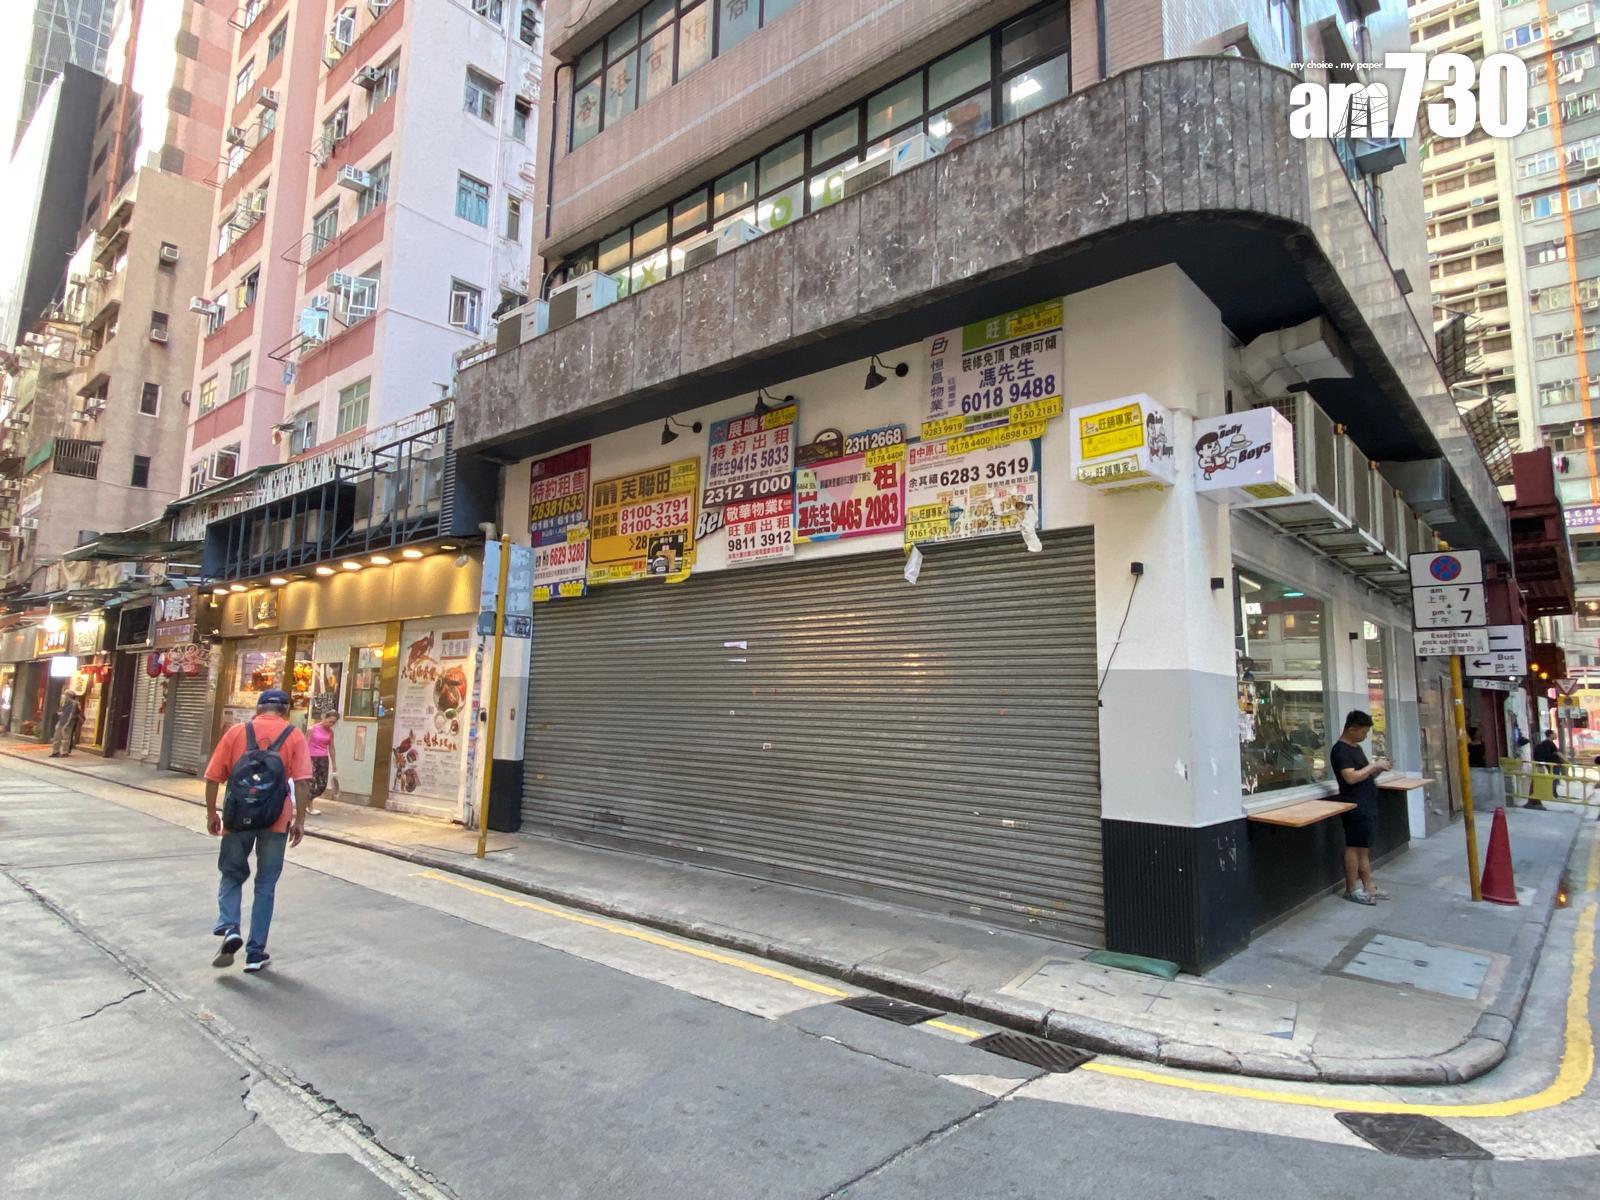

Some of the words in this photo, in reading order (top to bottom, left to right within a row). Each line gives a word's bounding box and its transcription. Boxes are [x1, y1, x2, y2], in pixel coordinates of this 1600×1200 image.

[962, 348, 1005, 372] 裝修免頂
[1009, 334, 1057, 360] 食牌可傾
[979, 358, 1035, 389] 馮先生
[962, 388, 1003, 413] 6018
[1010, 374, 1056, 402] 9488
[1013, 410, 1034, 421] 9150
[1036, 404, 1057, 416] 2181
[924, 427, 942, 437] 9283
[944, 422, 963, 433] 9919
[1000, 431, 1021, 442] 6898
[1023, 424, 1044, 437] 6317
[845, 437, 869, 455] 2311
[871, 428, 901, 449] 2668
[950, 442, 969, 453] 9178
[971, 436, 991, 448] 4400
[1239, 441, 1271, 464] Boys
[731, 453, 757, 475] 9415
[761, 445, 789, 468] 5833
[873, 462, 898, 491] 租
[940, 466, 979, 486] 6283
[986, 457, 1029, 479] 3619
[705, 485, 744, 505] 2312
[750, 474, 791, 496] 1000
[557, 511, 583, 526] 6119
[621, 497, 689, 521] 8100-3791
[831, 498, 862, 532] 9465
[865, 492, 899, 528] 2083
[620, 511, 690, 535] 8100-3334
[909, 529, 927, 538] 9161
[728, 536, 756, 552] 9811
[760, 530, 792, 547] 3912
[550, 545, 566, 567] 6629
[567, 541, 585, 563] 3288
[1427, 595, 1448, 604] 上午
[1458, 587, 1470, 602] 7
[1428, 617, 1449, 625] 下午
[1460, 610, 1472, 624] 7
[1494, 663, 1518, 673] 巴士
[1497, 653, 1515, 661] Bus
